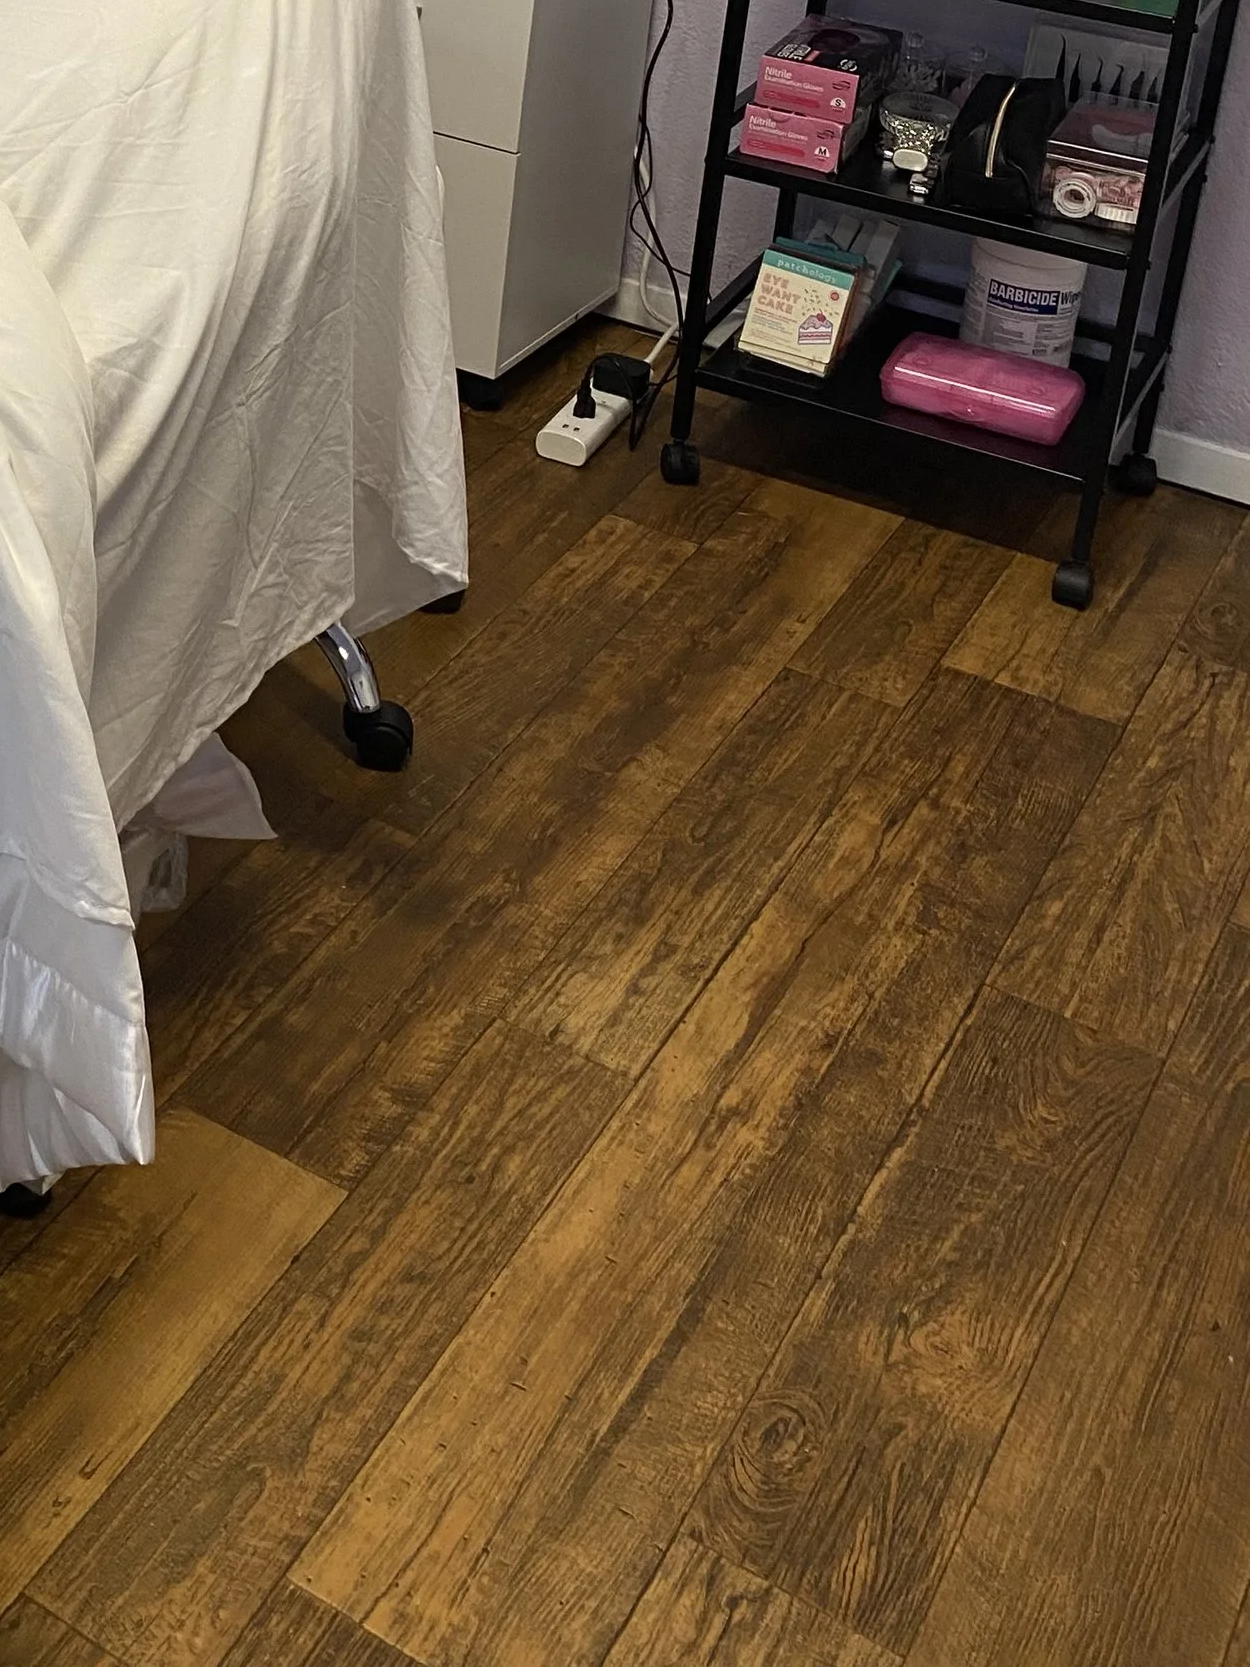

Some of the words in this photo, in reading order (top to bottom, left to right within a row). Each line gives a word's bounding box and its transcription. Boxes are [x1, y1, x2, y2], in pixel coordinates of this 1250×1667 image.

[765, 66, 792, 79] Nitrile
[764, 74, 803, 88] Examination
[803, 81, 824, 93] Gloves
[835, 99, 842, 107] S
[749, 115, 776, 129] Nitrile
[749, 124, 787, 137] Examination
[787, 131, 808, 141] Gloves
[818, 148, 827, 156] M
[777, 259, 837, 284] patchology
[763, 272, 789, 289] EYE
[760, 283, 801, 304] WANT
[990, 281, 1057, 306] BARBICIDE
[757, 295, 794, 315] CAKE
